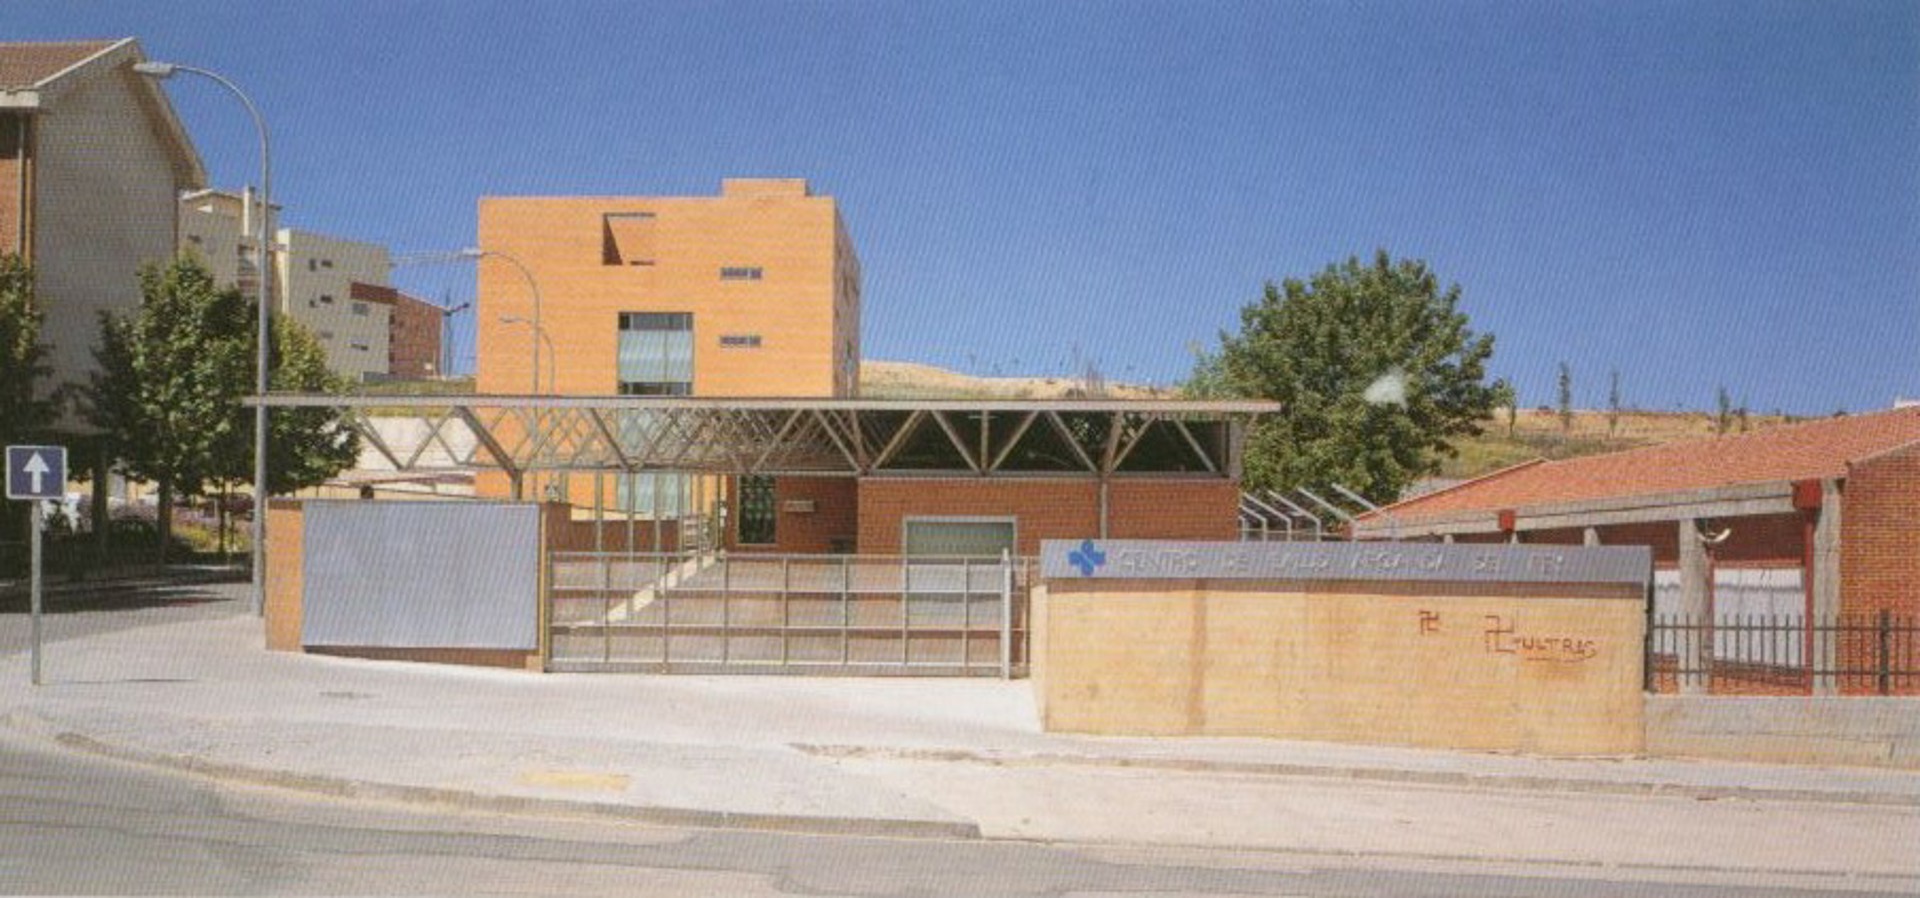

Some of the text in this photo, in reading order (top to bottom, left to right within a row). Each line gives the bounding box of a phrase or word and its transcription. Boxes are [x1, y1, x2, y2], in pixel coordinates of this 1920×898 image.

[1119, 549, 1199, 572] CENTRO
[1224, 551, 1249, 572] DE
[1474, 553, 1508, 575] DE
